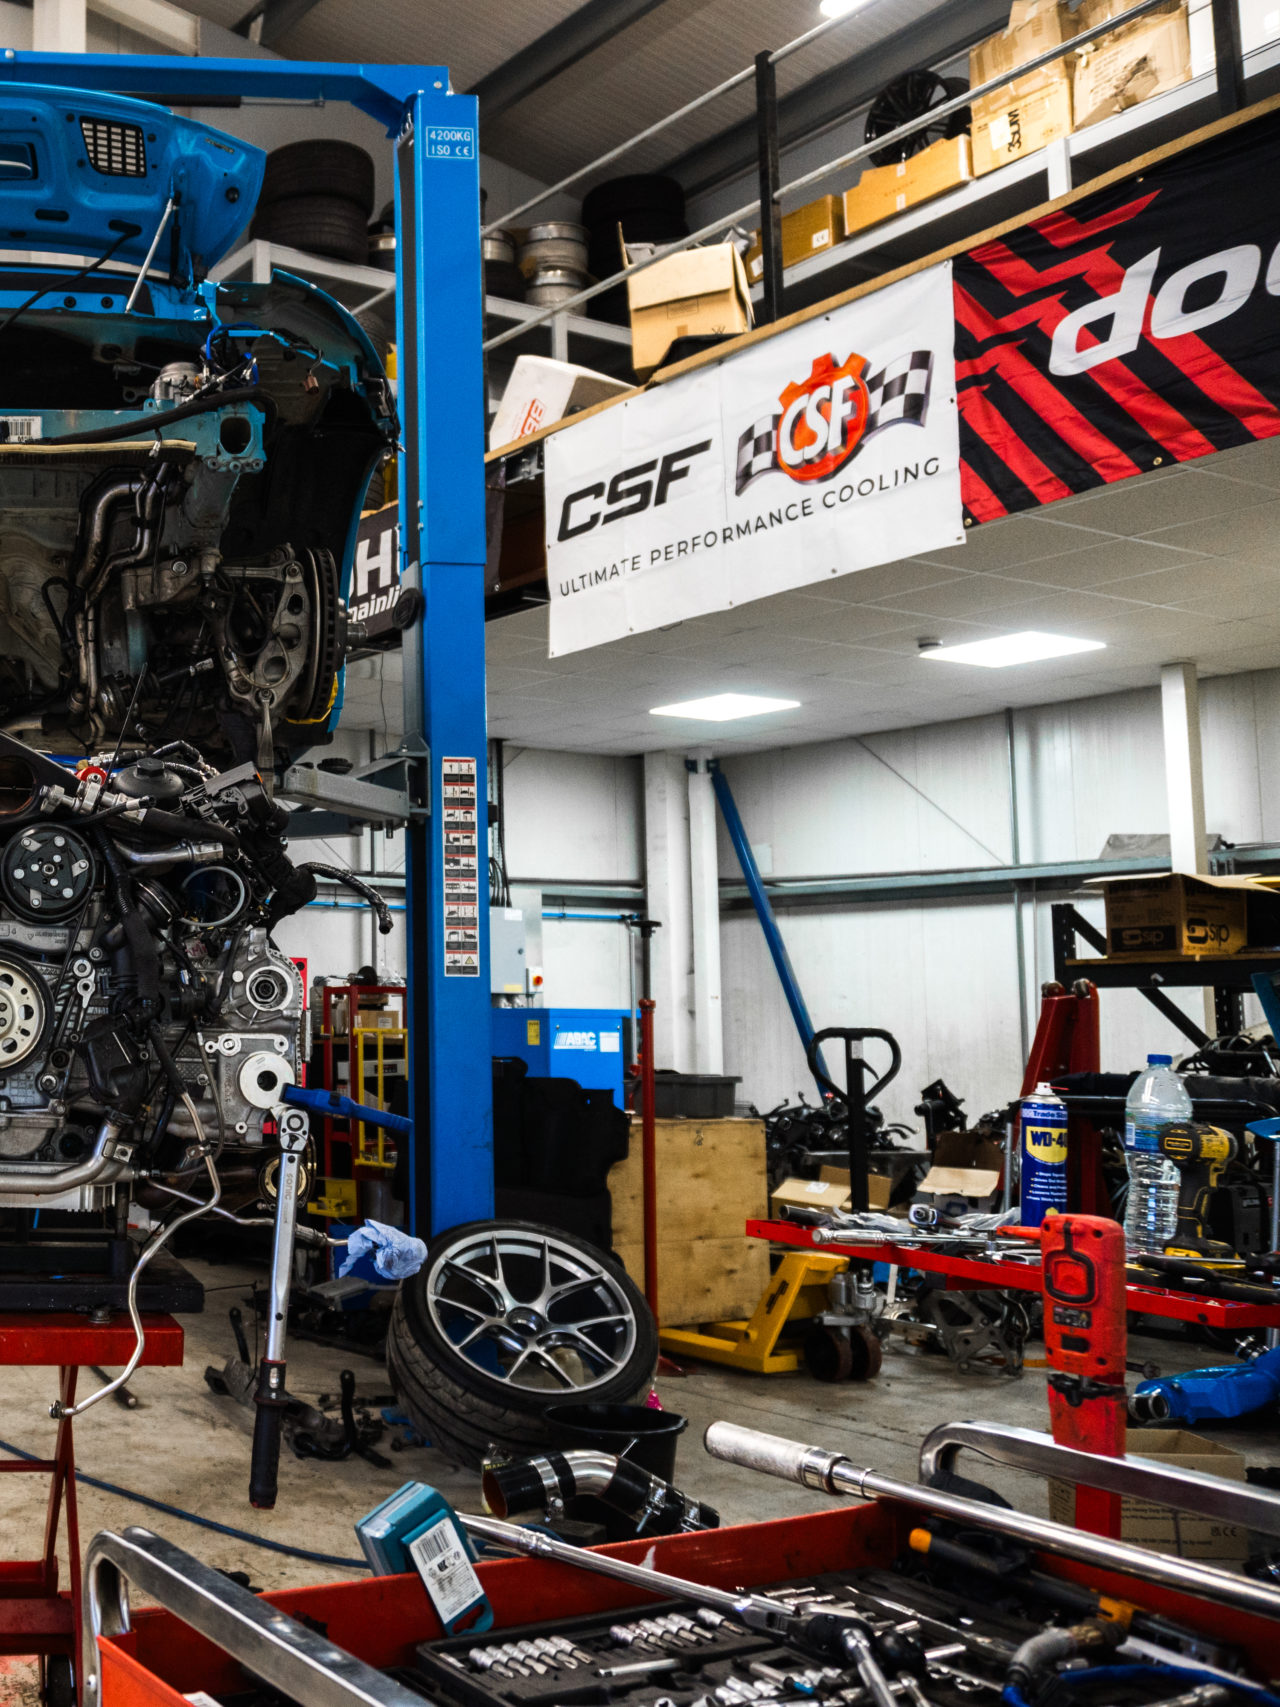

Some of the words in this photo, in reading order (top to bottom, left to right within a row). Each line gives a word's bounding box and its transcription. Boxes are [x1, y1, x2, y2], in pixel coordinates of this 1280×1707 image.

[429, 130, 471, 141] 4200KG
[431, 145, 450, 155] ISO
[1049, 240, 1280, 377] do
[779, 374, 856, 467] CSF
[557, 438, 713, 542] CSF
[560, 555, 641, 598] ULTIMATE
[650, 498, 814, 566] PERFORMANCE
[823, 457, 940, 508] COOLING
[348, 585, 403, 623] ainli
[565, 1032, 596, 1046] ABAC
